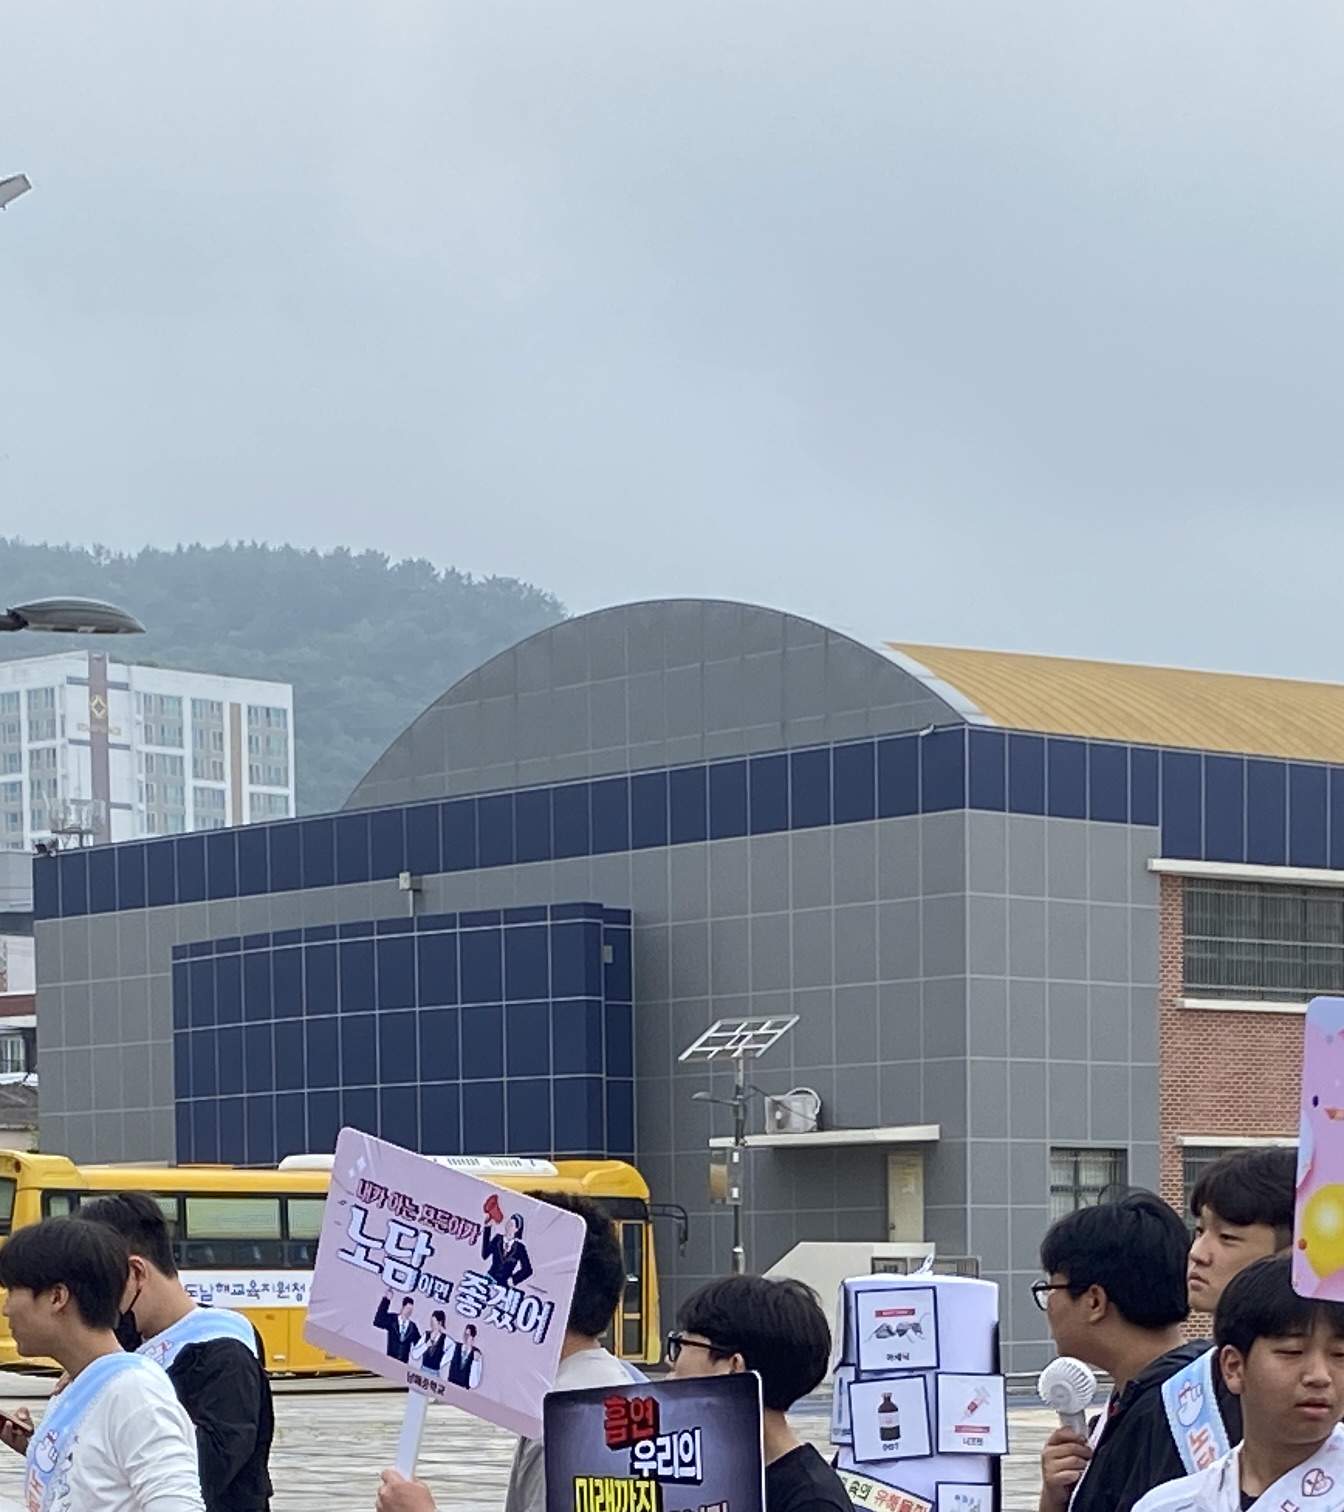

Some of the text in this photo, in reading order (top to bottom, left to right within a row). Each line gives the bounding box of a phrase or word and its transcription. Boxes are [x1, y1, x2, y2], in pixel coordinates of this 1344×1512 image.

[356, 1179, 389, 1210] 내가
[456, 1270, 555, 1344] 좋겠어
[603, 1396, 654, 1446] 흡연
[633, 1429, 703, 1480] 우리의
